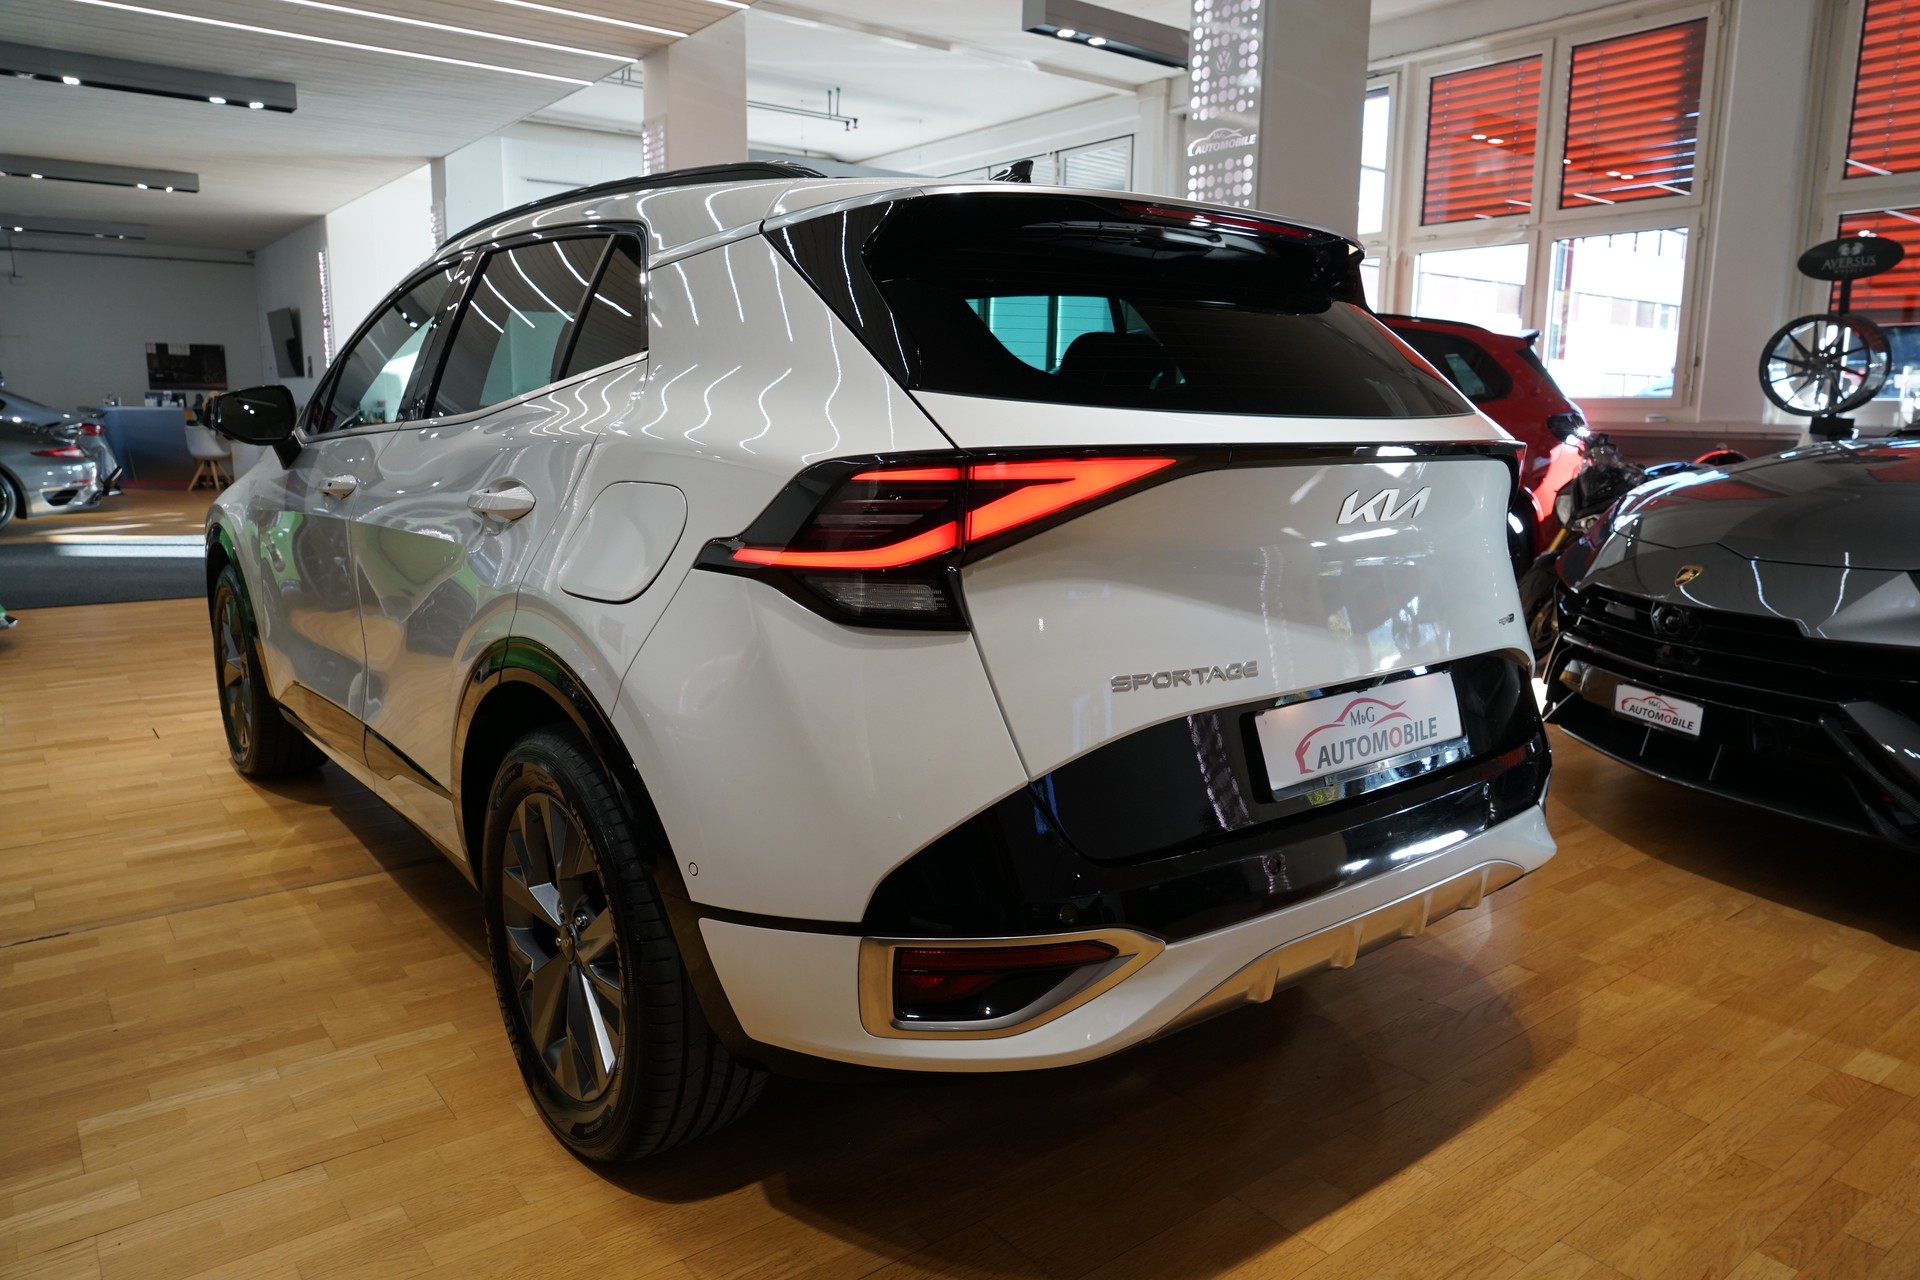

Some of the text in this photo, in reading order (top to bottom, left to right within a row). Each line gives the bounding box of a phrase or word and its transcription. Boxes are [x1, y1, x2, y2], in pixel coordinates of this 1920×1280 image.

[1195, 134, 1257, 155] AUTOMOBILE
[1821, 255, 1877, 271] AVERSUS
[1111, 660, 1259, 693] SPORTAGE
[1349, 706, 1375, 727] M&G
[1629, 704, 1695, 730] AUTOMOBILE
[1317, 717, 1438, 769] AUTOMOBILE
